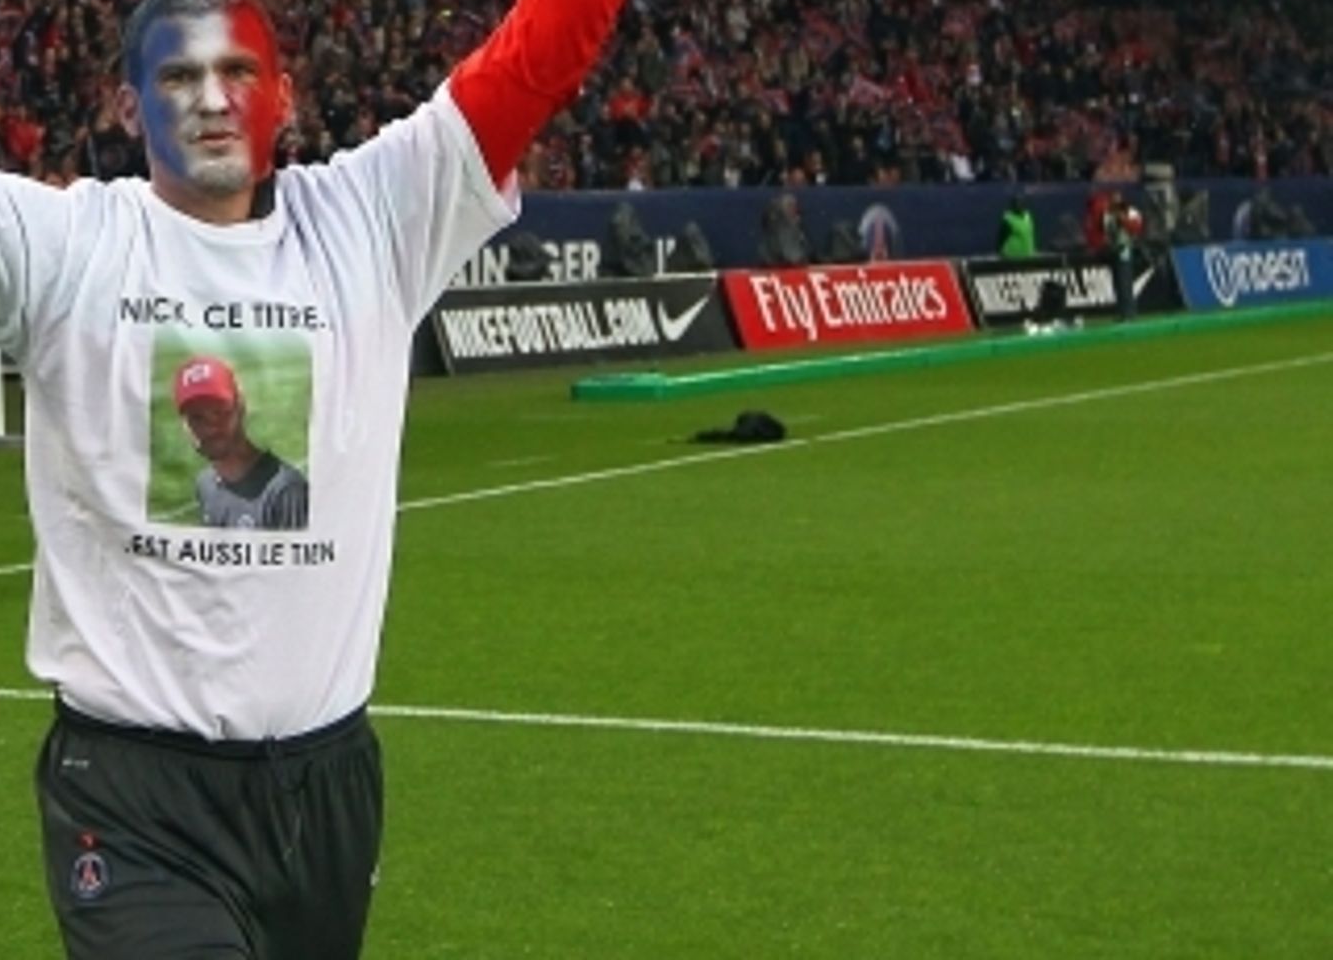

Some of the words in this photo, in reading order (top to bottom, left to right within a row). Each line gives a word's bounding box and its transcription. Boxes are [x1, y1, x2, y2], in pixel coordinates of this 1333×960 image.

[441, 297, 659, 358] NIKEFOOTBALL.COM
[749, 272, 818, 341] Fly
[808, 267, 947, 328] Emirates
[178, 540, 252, 565] AUSSI
[259, 542, 285, 566] LE
